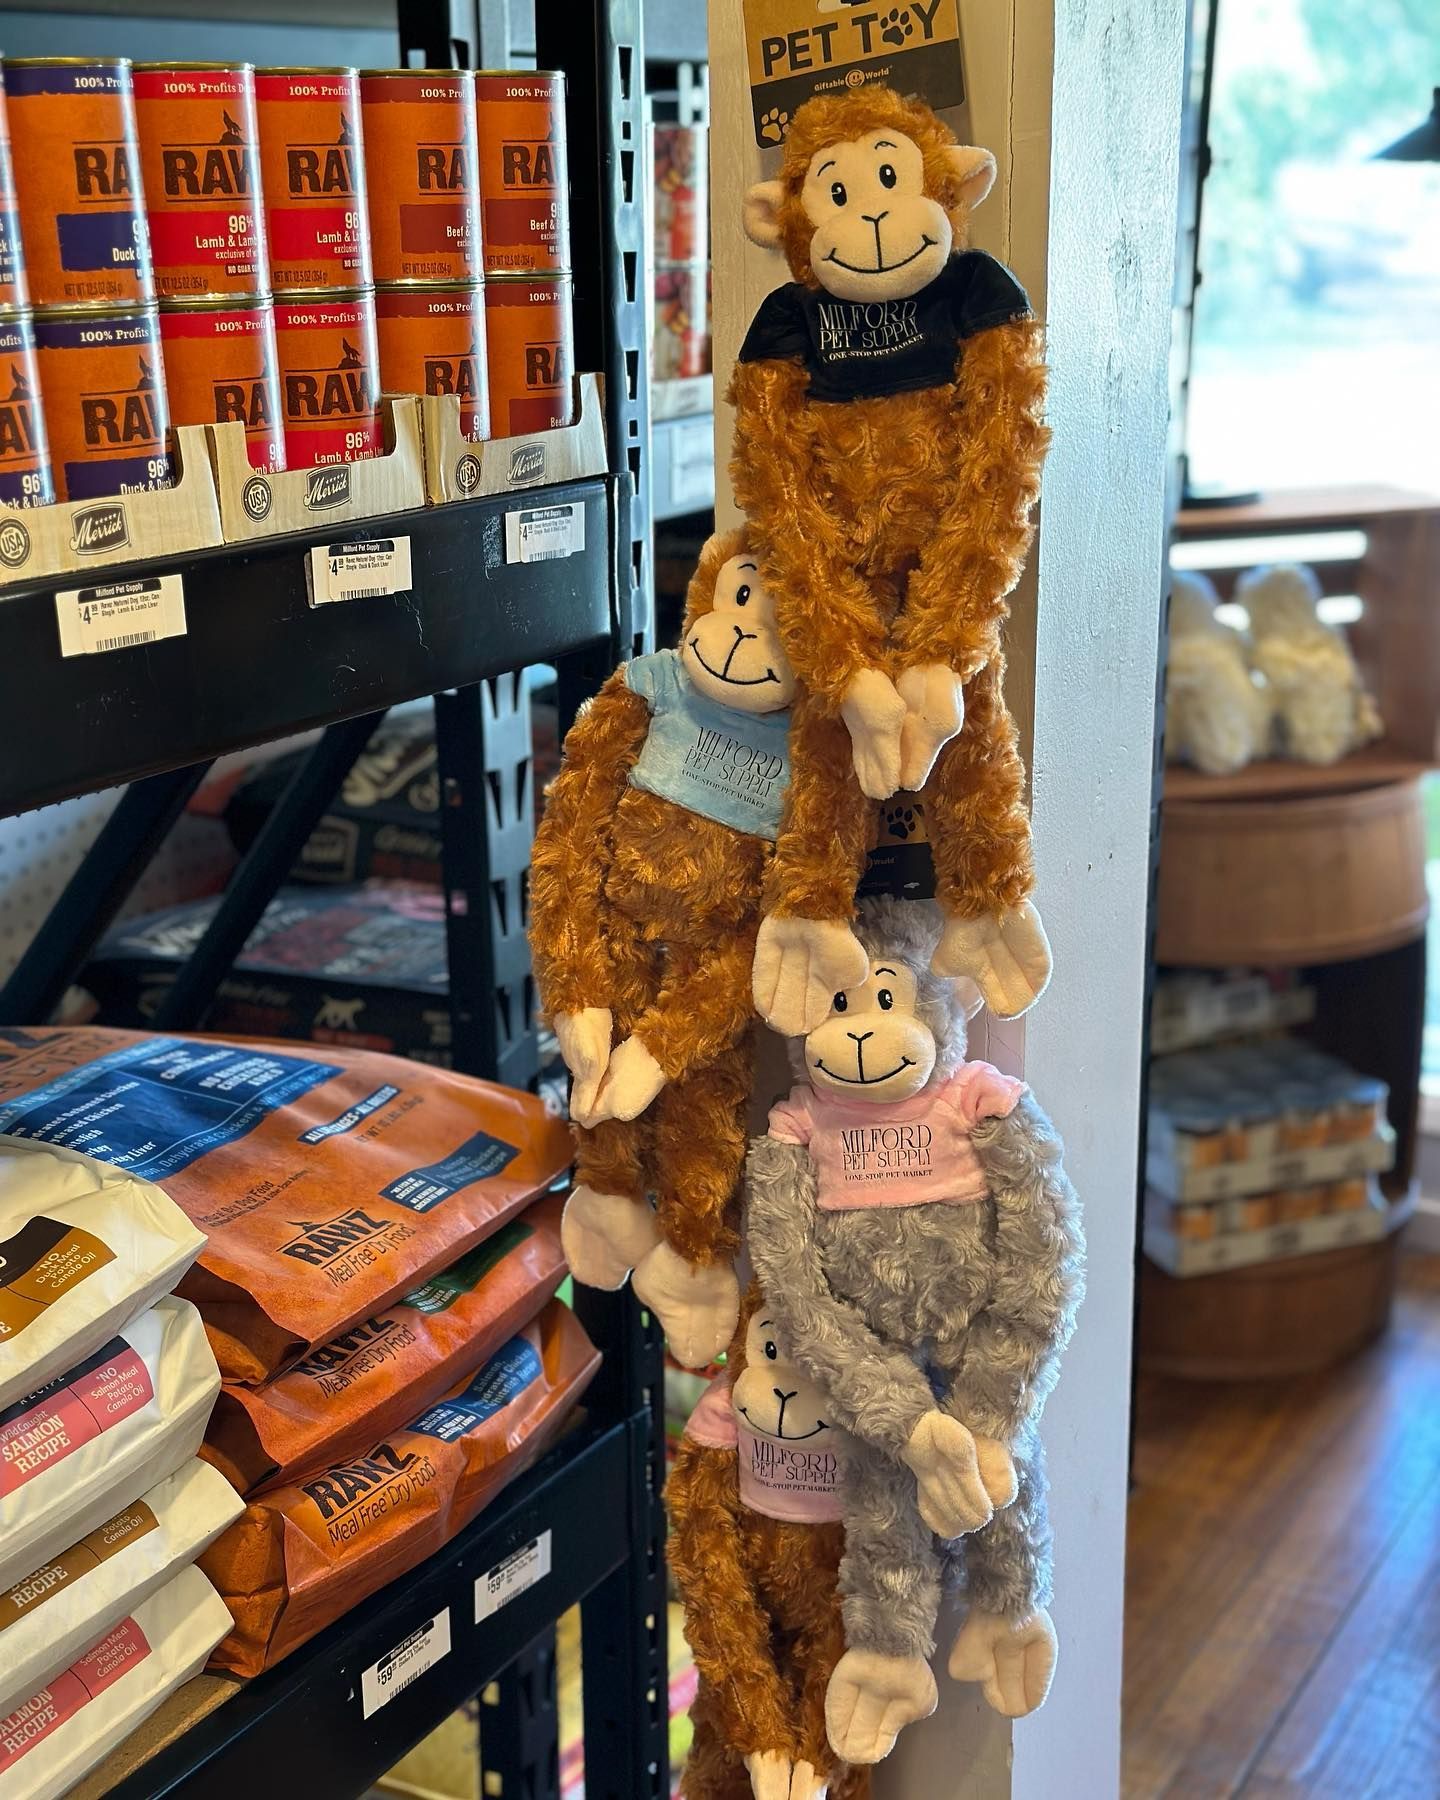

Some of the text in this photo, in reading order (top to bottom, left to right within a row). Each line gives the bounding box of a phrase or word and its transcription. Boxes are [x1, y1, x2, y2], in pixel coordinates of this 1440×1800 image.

[761, 22, 839, 77] PET
[74, 77, 105, 88] 100%
[164, 82, 196, 94] 100%
[200, 81, 237, 93] Profits
[814, 67, 890, 92] Giftable World
[289, 86, 319, 97] 100%
[421, 88, 447, 98] 100%
[506, 87, 532, 97] 100%
[446, 226, 464, 237] Beef
[530, 219, 555, 231] Beef &
[195, 235, 225, 248] Lamb
[228, 234, 236, 247] &
[316, 230, 351, 244] Lamb &
[112, 247, 136, 262] Duck
[215, 248, 245, 260] exclusive
[428, 303, 454, 313] 100%
[529, 292, 552, 302] 100%
[214, 320, 243, 333] 100%
[287, 315, 318, 326] 100%
[320, 312, 356, 324] Profits
[818, 301, 918, 331] MILFORD
[80, 327, 150, 343] 100% Profits
[820, 316, 919, 350] PET SUPPLY
[873, 348, 890, 357] PET
[891, 333, 925, 352] MARKET
[345, 431, 370, 450] 96%
[315, 446, 374, 465] Lamb & Lamb
[507, 450, 544, 481] Merrick
[269, 462, 276, 474] &
[461, 465, 476, 483] USA
[120, 480, 146, 496] Duck
[148, 478, 157, 492] &
[304, 473, 348, 506] Merrick
[23, 496, 32, 510] &
[249, 489, 268, 509] USA
[70, 511, 123, 551] Merrick
[2, 533, 25, 554] USA
[115, 585, 125, 595] Pet
[126, 582, 144, 593] Supply
[696, 726, 784, 780] MILFORD
[684, 746, 775, 798] PET SUPPLY
[84, 1103, 126, 1123] Chicken
[131, 1140, 157, 1160] Liver
[841, 1124, 933, 1154] MILFORD
[84, 1143, 112, 1158] urkey
[842, 1149, 932, 1171] PET SUPPLY
[885, 1170, 900, 1178] PET
[902, 1169, 933, 1177] MARKET
[282, 1210, 391, 1266] RAWZ
[36, 1243, 81, 1284] Duck Meal
[50, 1254, 81, 1280] Potato
[51, 1251, 97, 1289] Canola Oil
[324, 1258, 356, 1288] Meal
[346, 1248, 377, 1272] Free
[317, 1324, 417, 1399] Meal Free Dry Food
[91, 1365, 139, 1400] Salmon Meal
[107, 1382, 134, 1401] Potato
[106, 1384, 145, 1413] Canola Oil
[17, 1410, 49, 1436] Caught
[2, 1414, 65, 1462] SALMON
[14, 1431, 72, 1475] RECIPE
[752, 1439, 837, 1474] MILFORD
[302, 1444, 415, 1519] RAWZ
[751, 1459, 838, 1485] PET SUPPLY
[792, 1484, 806, 1492] PET
[328, 1458, 437, 1548] Meal Free Dry Food
[102, 1515, 131, 1535] Potato
[103, 1514, 144, 1545] Canola Oil
[10, 1565, 70, 1609] RECIPE
[80, 1625, 130, 1667] Salmon Meal
[96, 1643, 125, 1666] Potato
[96, 1642, 138, 1679] Canola Oil
[377, 1666, 392, 1685] $59
[0, 1689, 54, 1740] ALMON
[2, 1704, 59, 1755] RECIPE
